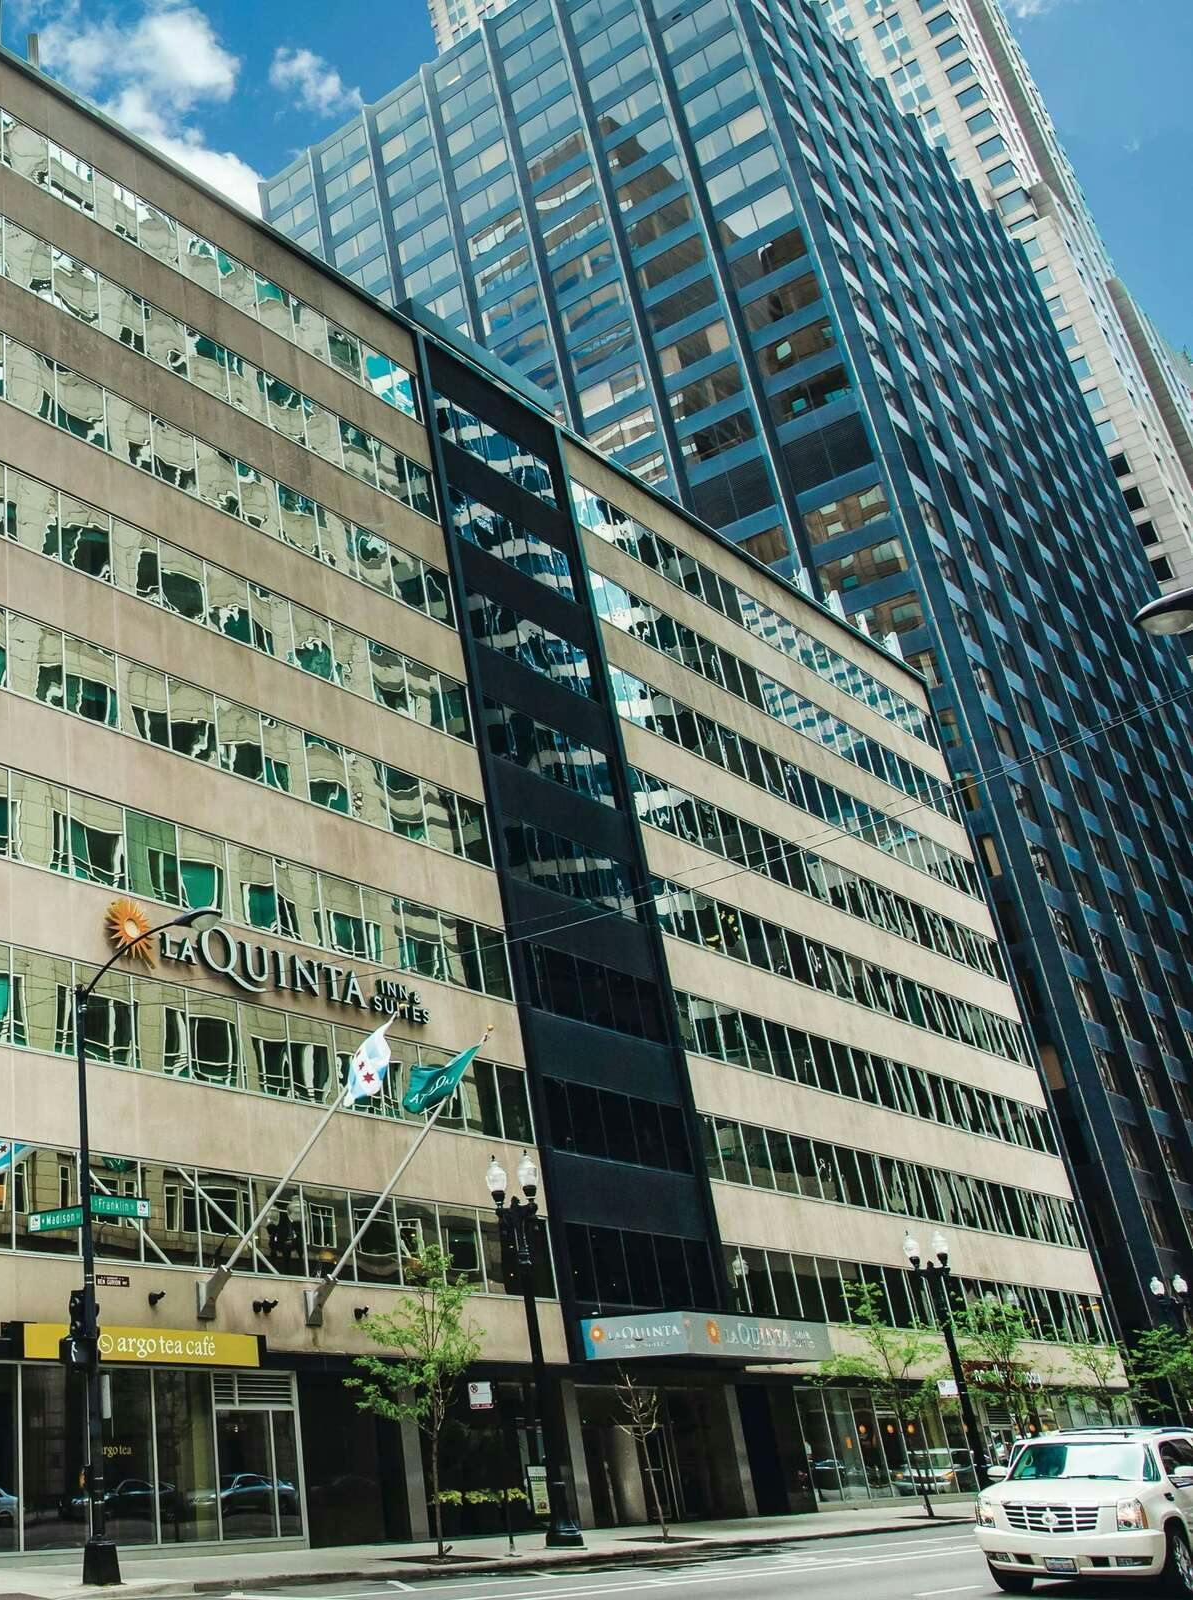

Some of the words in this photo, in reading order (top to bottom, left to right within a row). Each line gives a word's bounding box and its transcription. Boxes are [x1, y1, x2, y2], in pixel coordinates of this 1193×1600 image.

[159, 931, 198, 966] LA
[198, 926, 369, 1010] QUINTA
[379, 979, 409, 1000] INN
[413, 991, 422, 1003] &
[374, 996, 431, 1024] SUITES
[98, 1198, 129, 1212] Franklin
[46, 1213, 75, 1225] Madison
[621, 1325, 681, 1342] QUINTA
[737, 1322, 792, 1350] QUINTA
[117, 1336, 157, 1358] argo
[158, 1335, 183, 1354] tea
[186, 1335, 216, 1356] café
[103, 1446, 119, 1458] rgo
